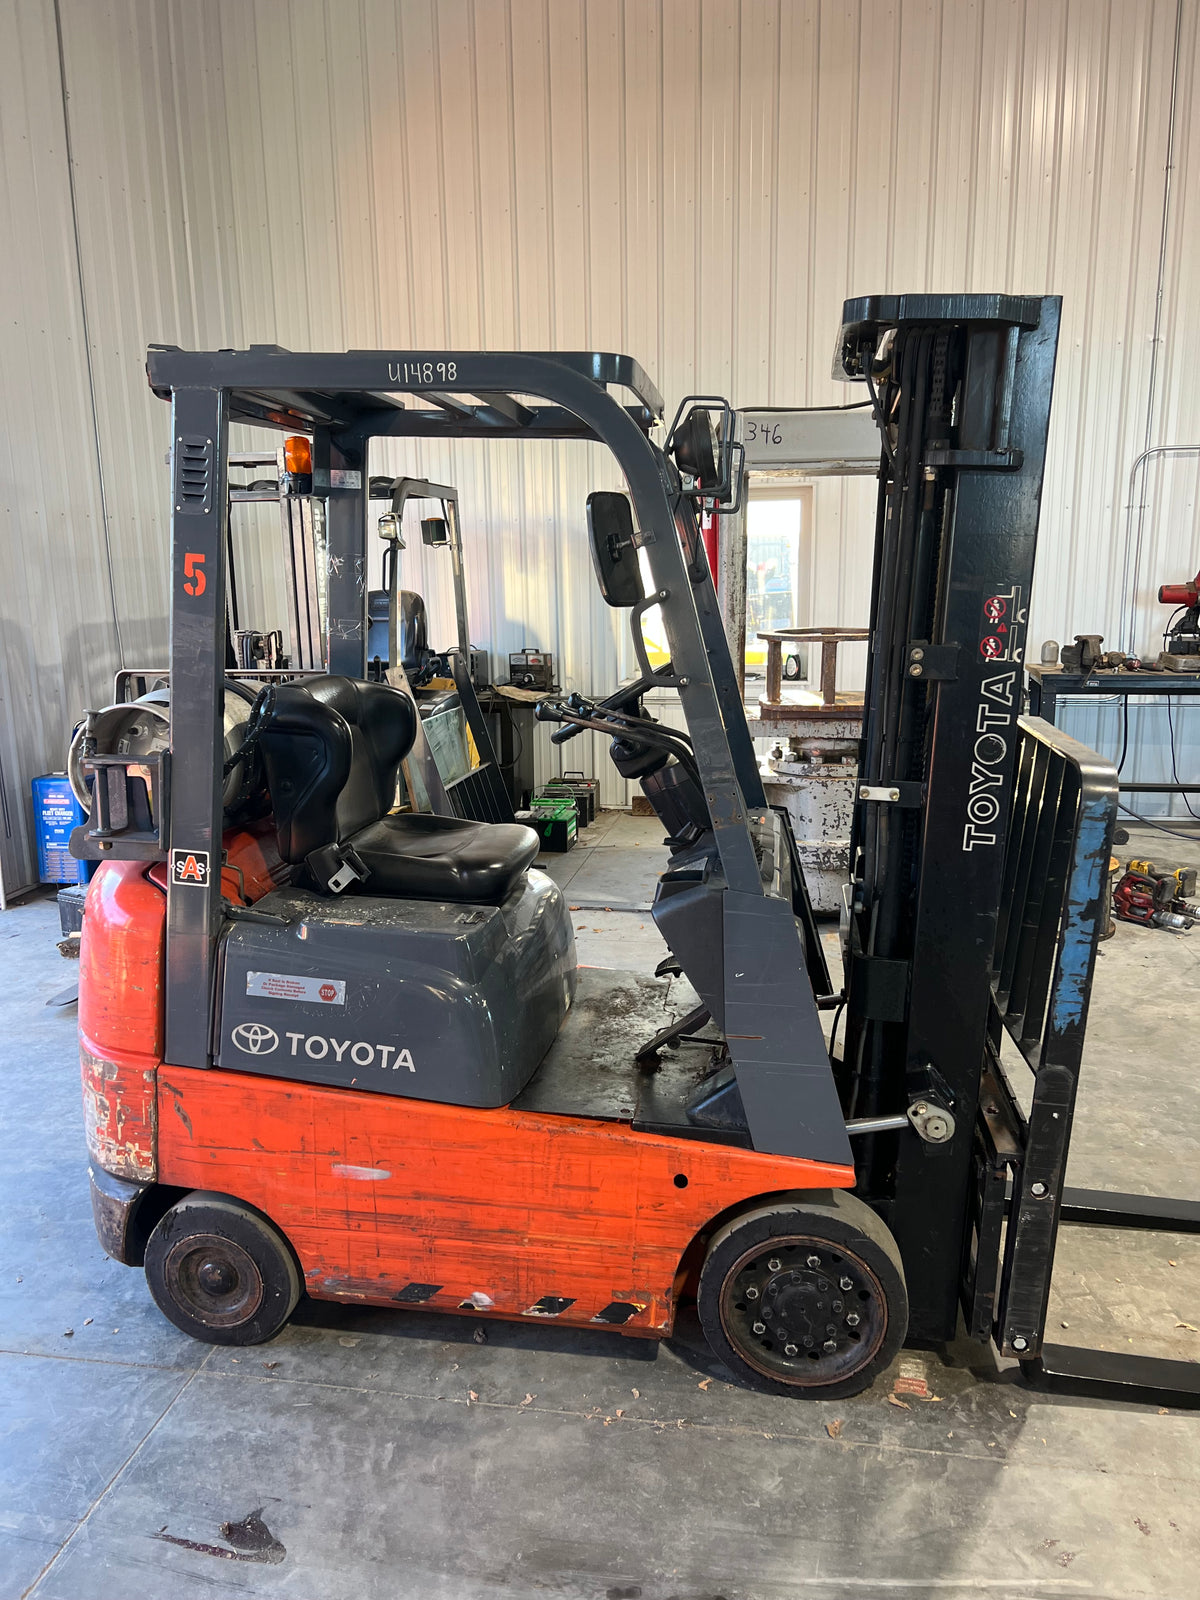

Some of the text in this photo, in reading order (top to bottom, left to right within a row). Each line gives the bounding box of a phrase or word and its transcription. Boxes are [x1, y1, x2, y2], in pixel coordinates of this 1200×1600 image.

[744, 421, 783, 445] 346
[183, 552, 207, 597] 5
[963, 671, 1017, 851] TOYOTA
[176, 855, 206, 881] SAS
[285, 1032, 416, 1073] TOYOTA
